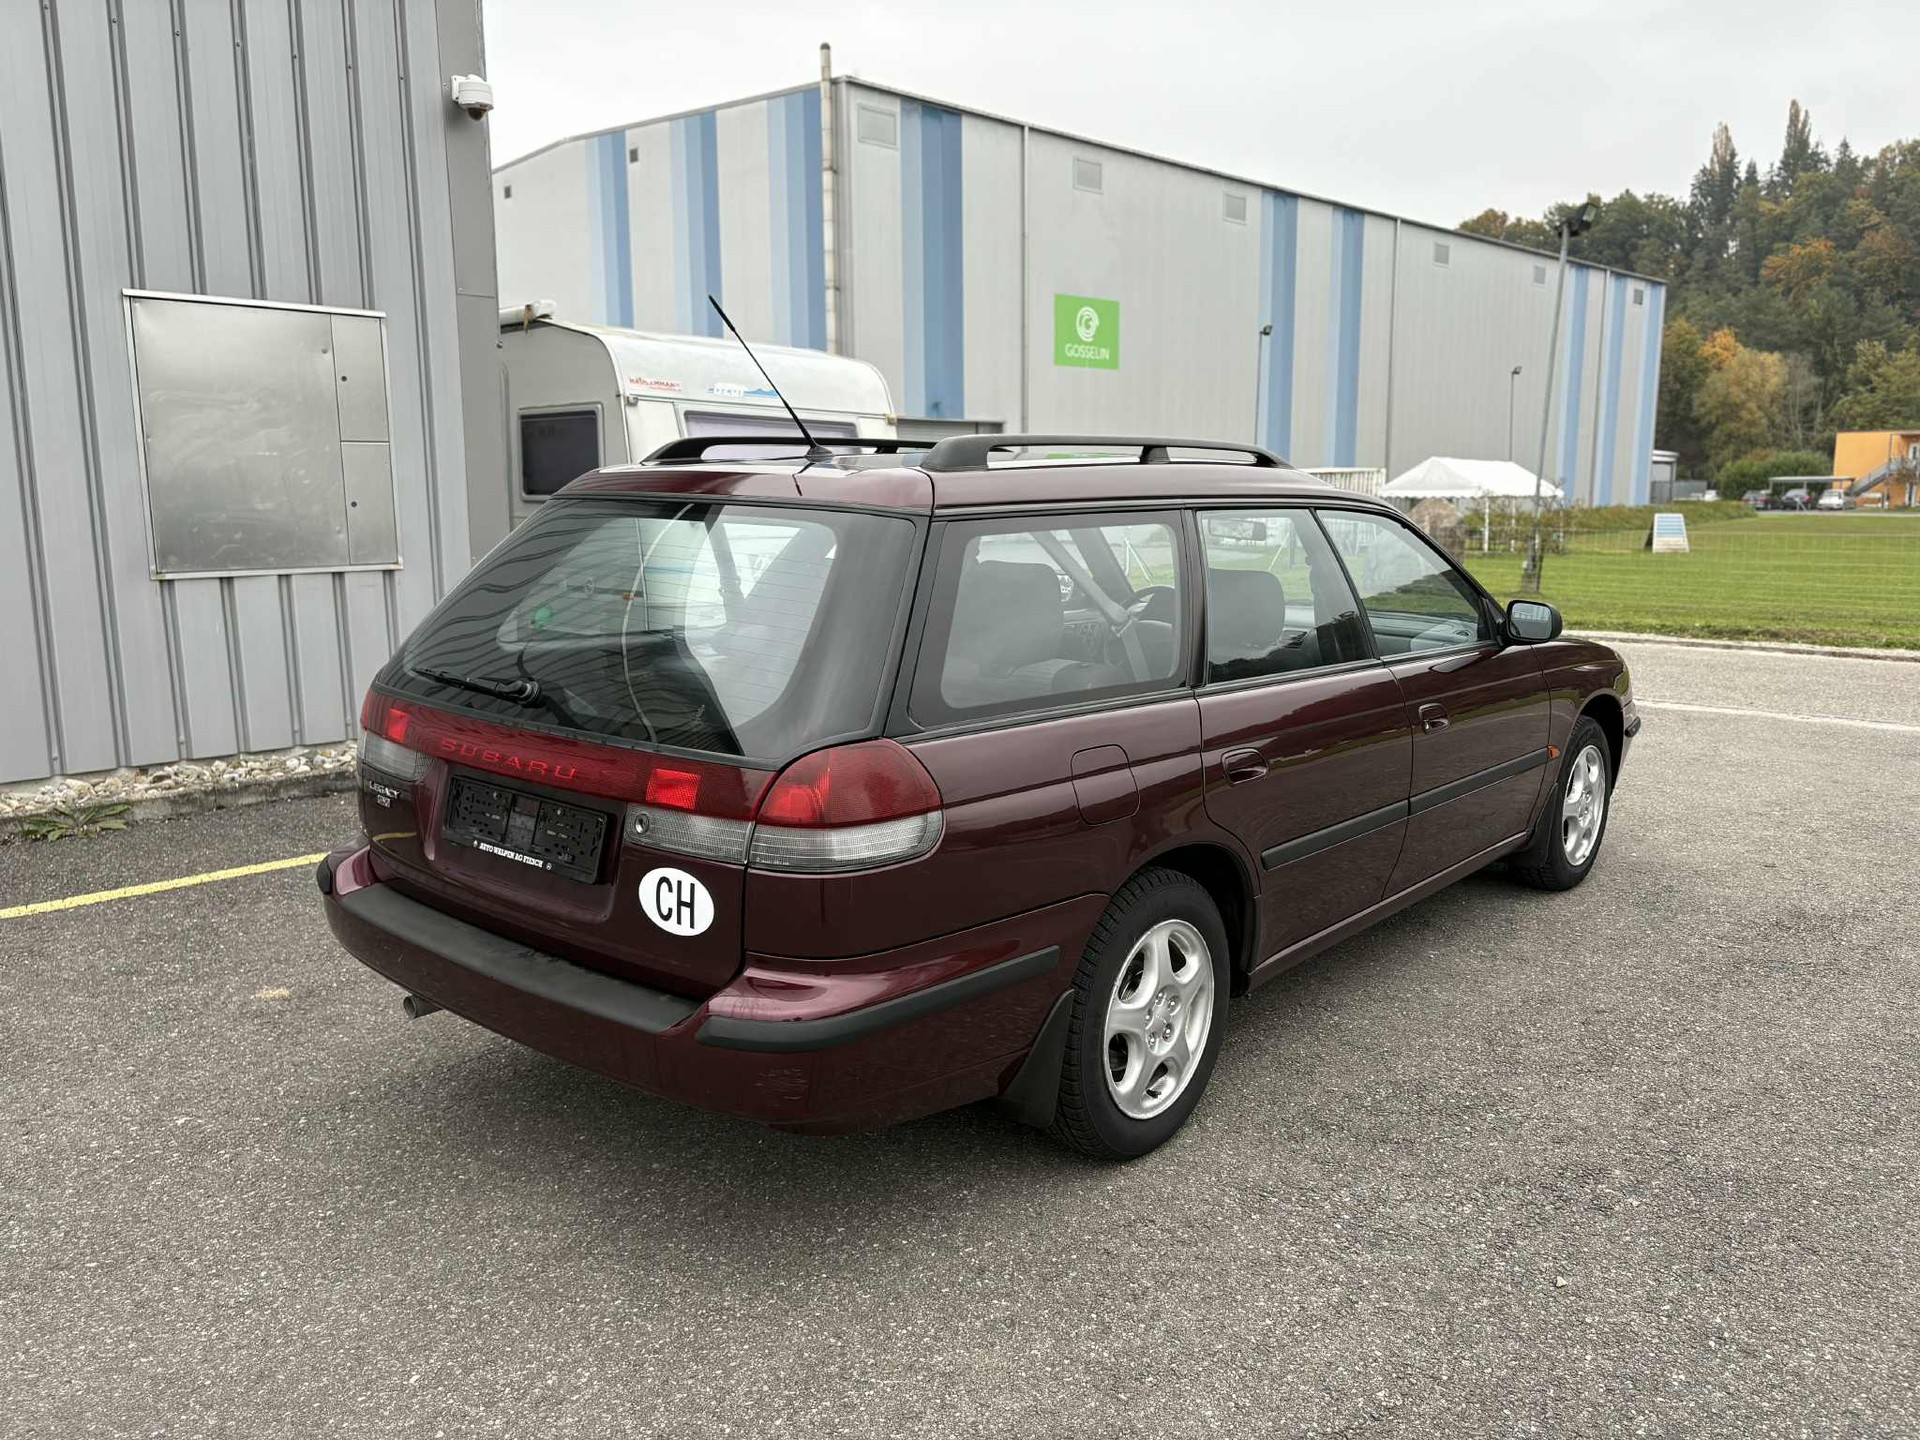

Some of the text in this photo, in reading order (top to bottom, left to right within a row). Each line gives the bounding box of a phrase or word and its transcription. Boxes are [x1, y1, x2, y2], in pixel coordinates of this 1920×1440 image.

[1064, 343, 1110, 361] GOSSELIN
[441, 739, 577, 780] SUBARU
[369, 780, 400, 800] LEGACY
[479, 842, 494, 853] AUTO
[655, 876, 696, 930] CH
